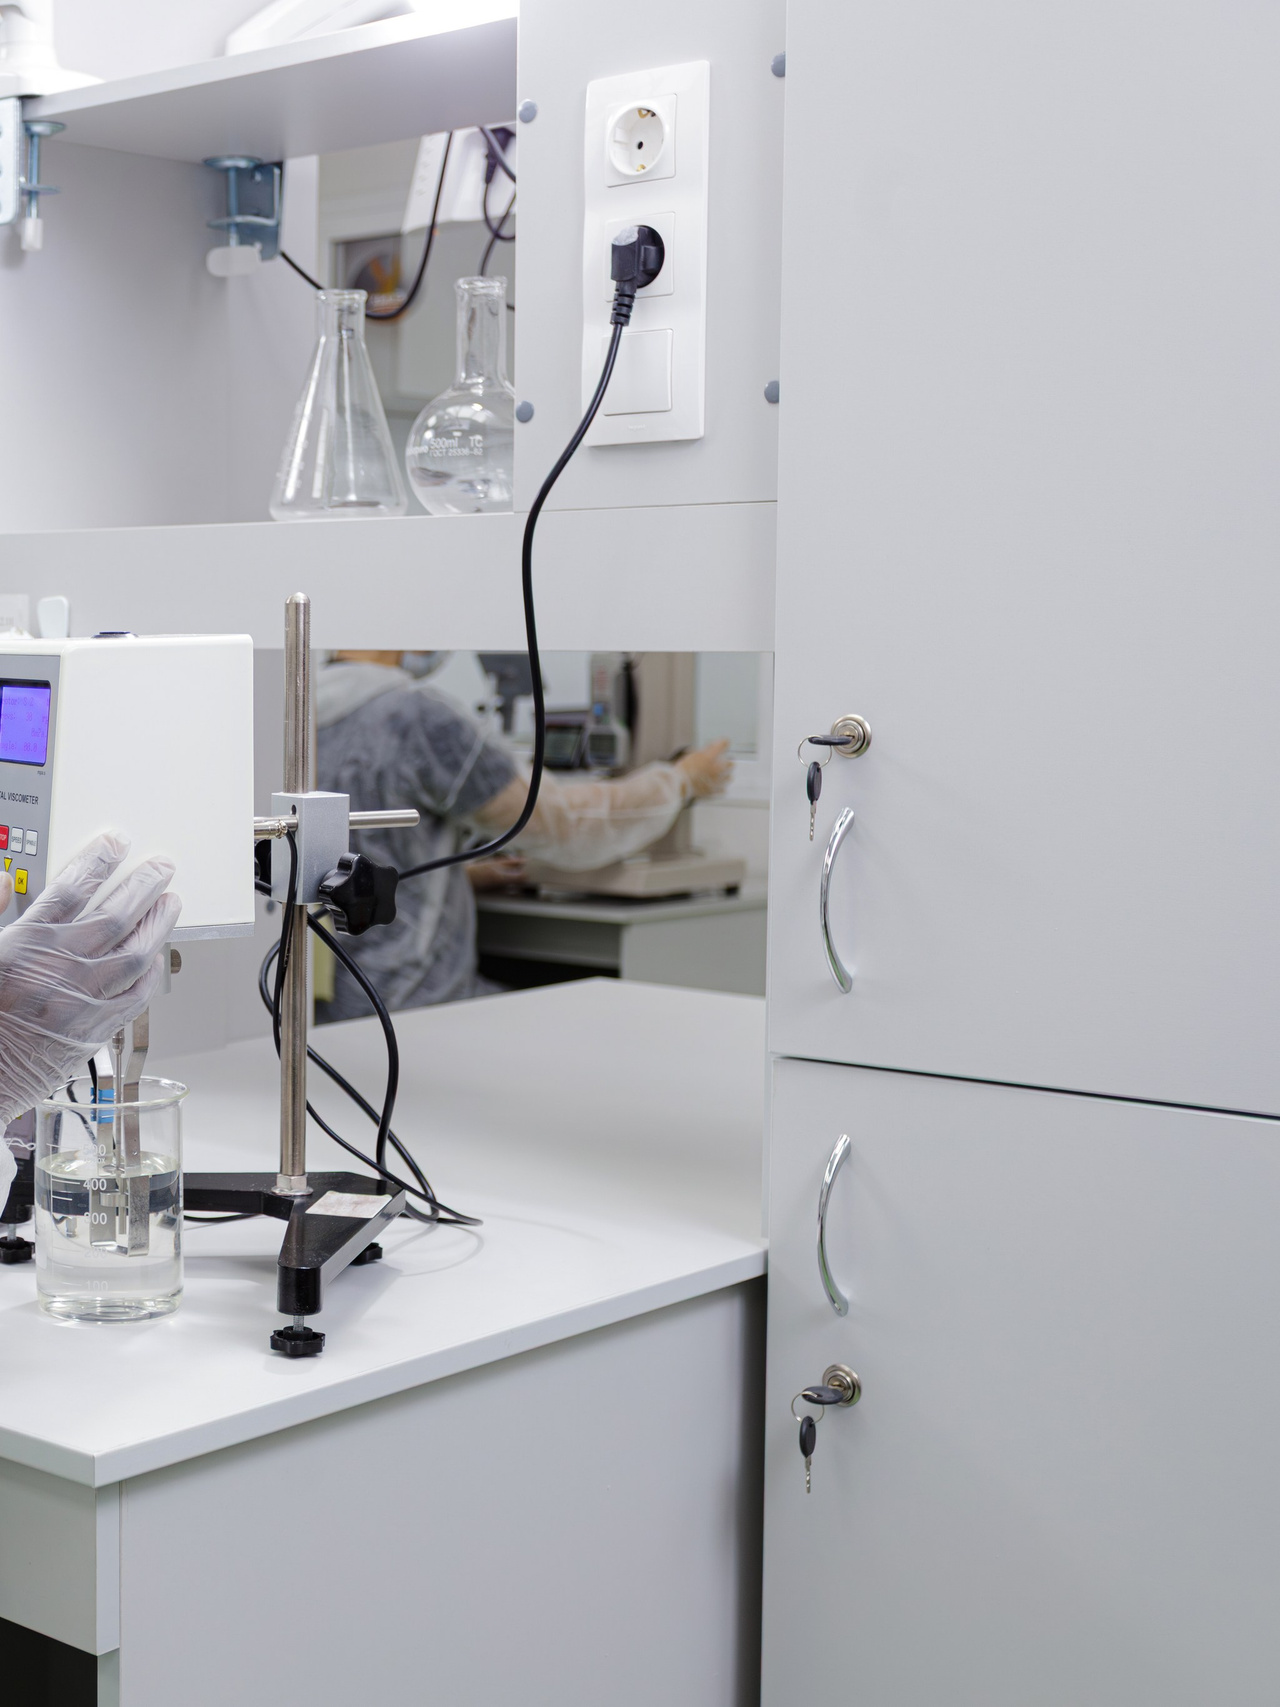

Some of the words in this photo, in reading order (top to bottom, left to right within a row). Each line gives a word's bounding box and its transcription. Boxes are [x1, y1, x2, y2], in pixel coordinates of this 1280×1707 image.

[468, 435, 483, 448] TC
[7, 791, 39, 805] VISCOMETER
[17, 877, 24, 885] OK
[82, 1178, 107, 1191] 400
[85, 1279, 109, 1292] 100
